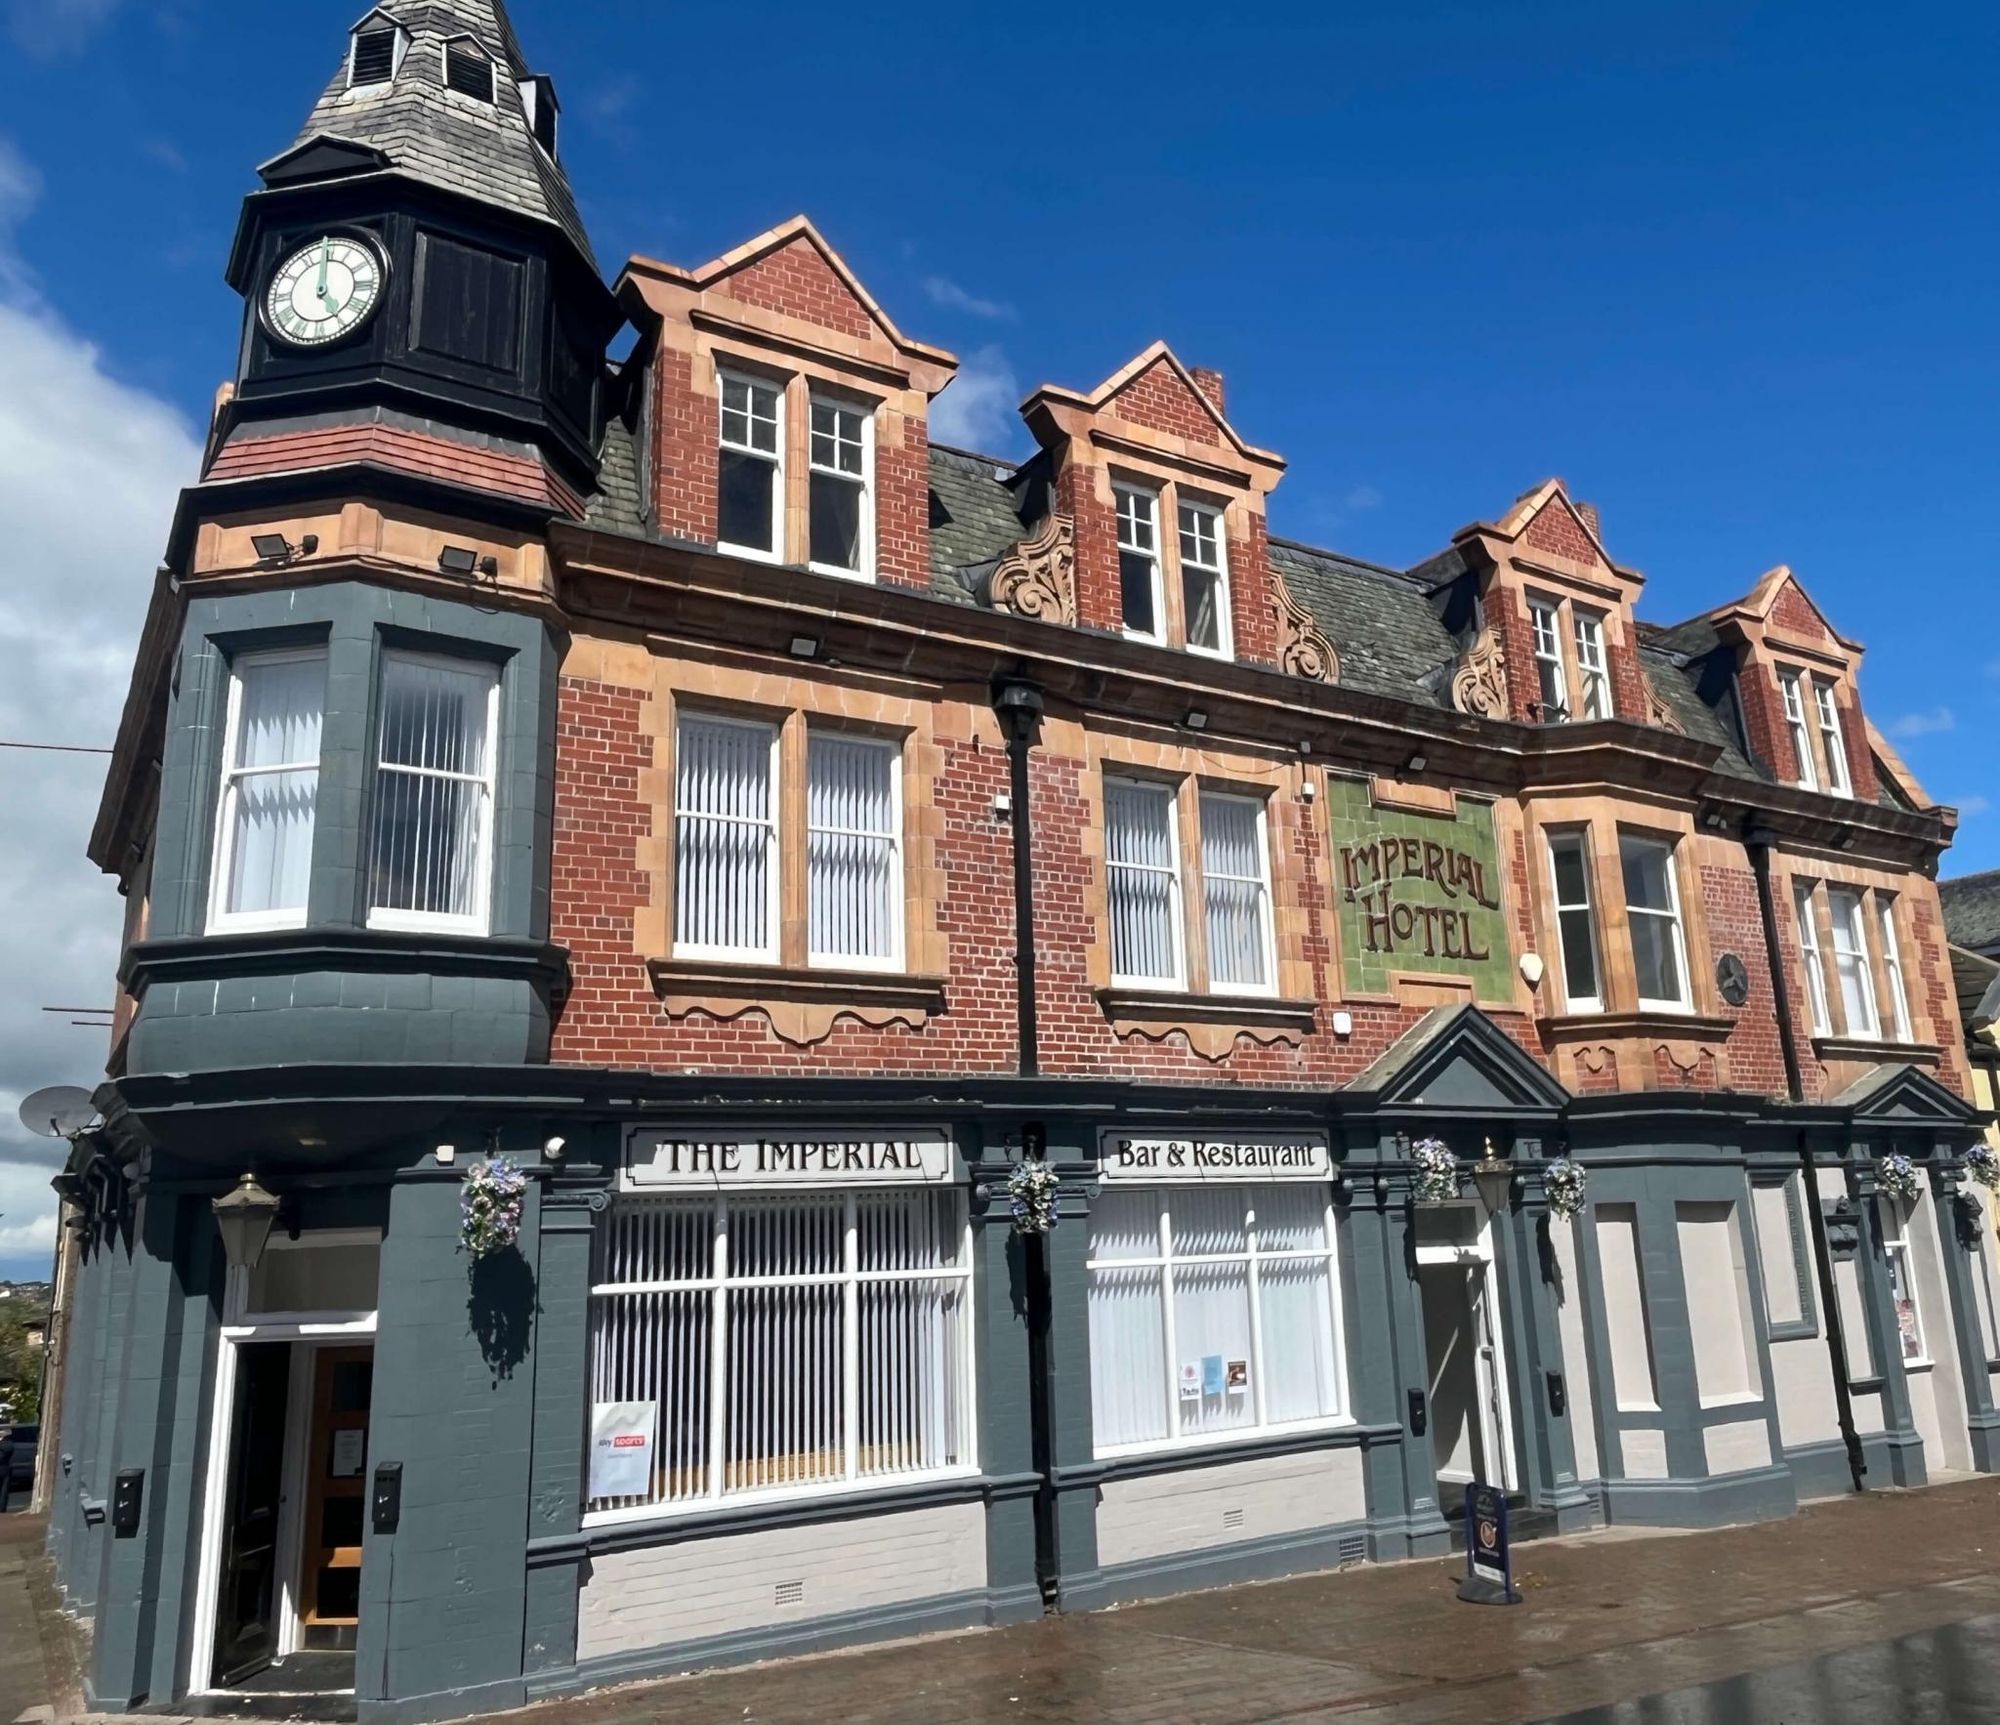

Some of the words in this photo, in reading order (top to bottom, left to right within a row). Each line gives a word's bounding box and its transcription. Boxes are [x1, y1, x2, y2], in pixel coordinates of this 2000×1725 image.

[1340, 838, 1499, 911] IMPERIAL
[1361, 888, 1489, 960] HOTEL
[662, 1138, 742, 1173] THE
[755, 1138, 922, 1172] IMPERIAL
[1118, 1140, 1160, 1167] Bar
[1167, 1141, 1186, 1168] &
[1192, 1140, 1315, 1168] Restaurant
